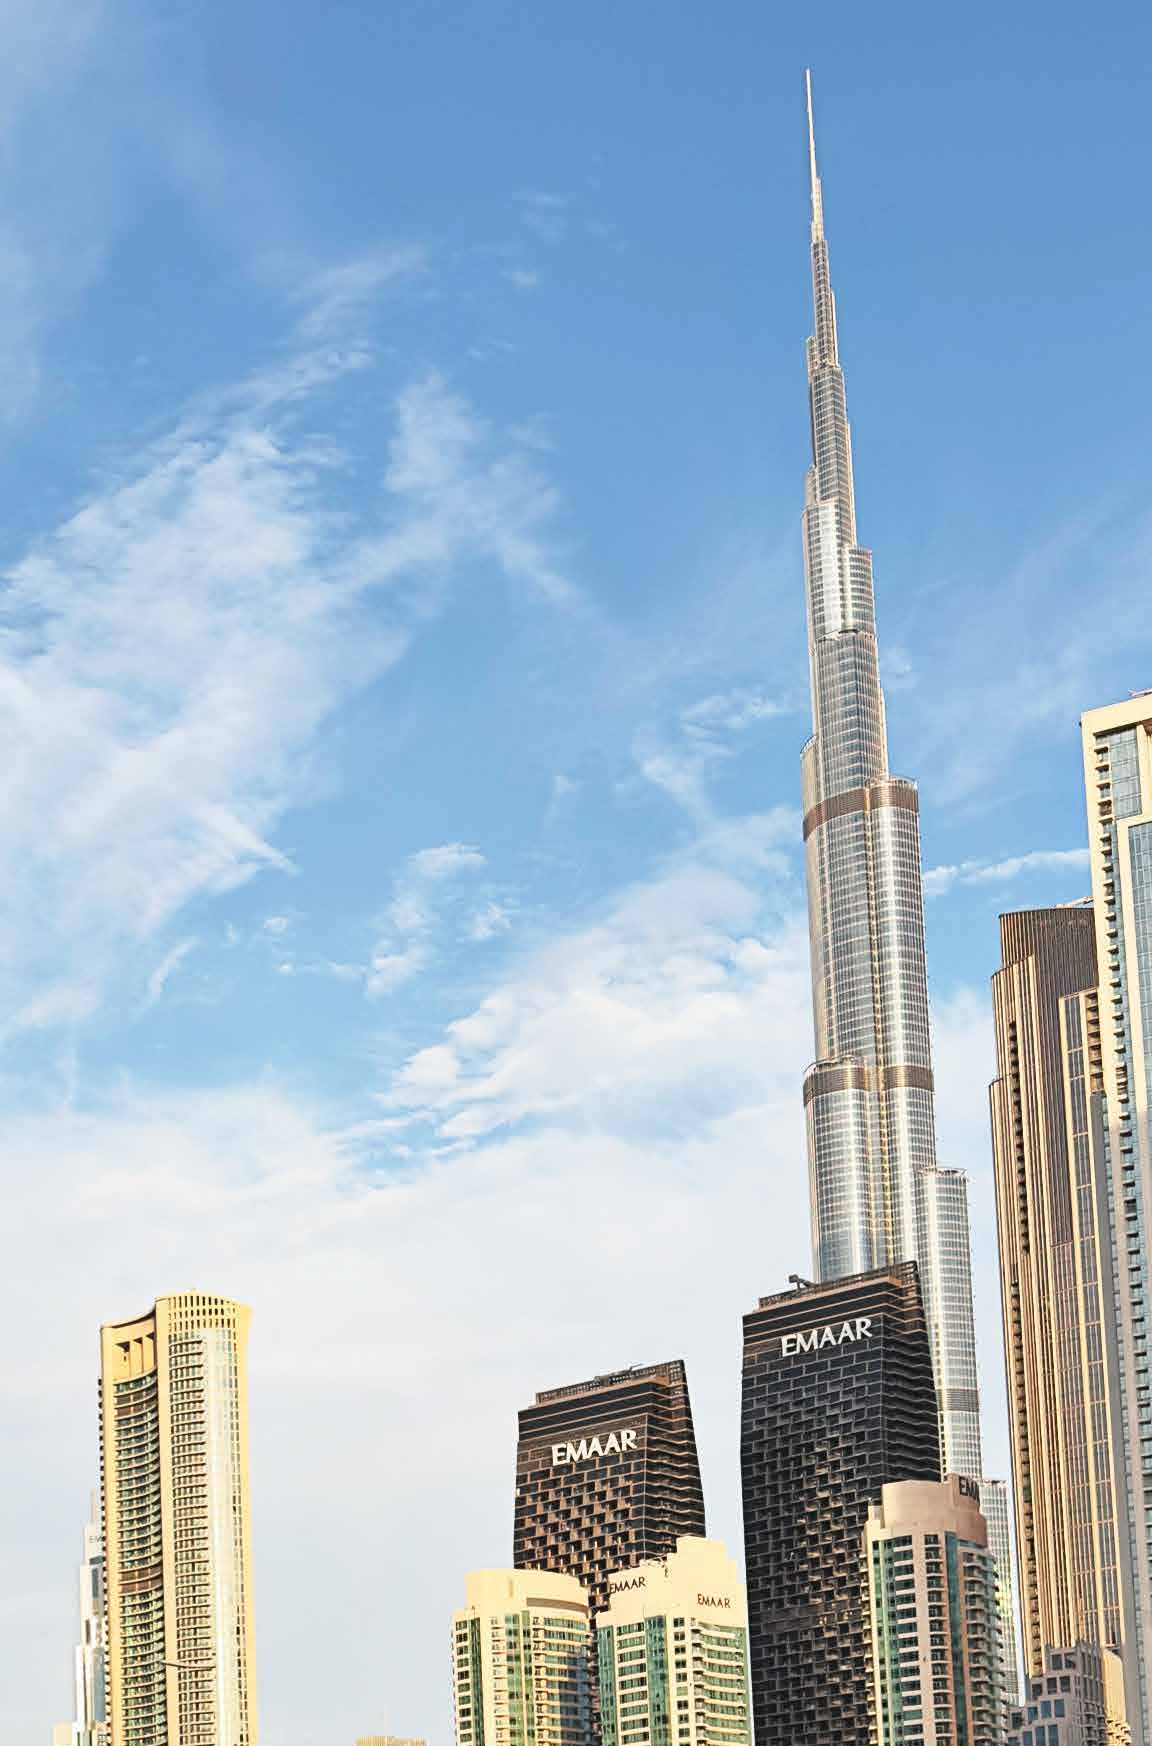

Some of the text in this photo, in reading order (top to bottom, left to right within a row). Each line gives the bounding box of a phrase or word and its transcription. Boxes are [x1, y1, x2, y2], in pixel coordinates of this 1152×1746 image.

[781, 1318, 873, 1357] EMAAR
[551, 1429, 638, 1466] EMAAR
[609, 1576, 647, 1594] EMAAR
[697, 1593, 732, 1609] EMAAR
